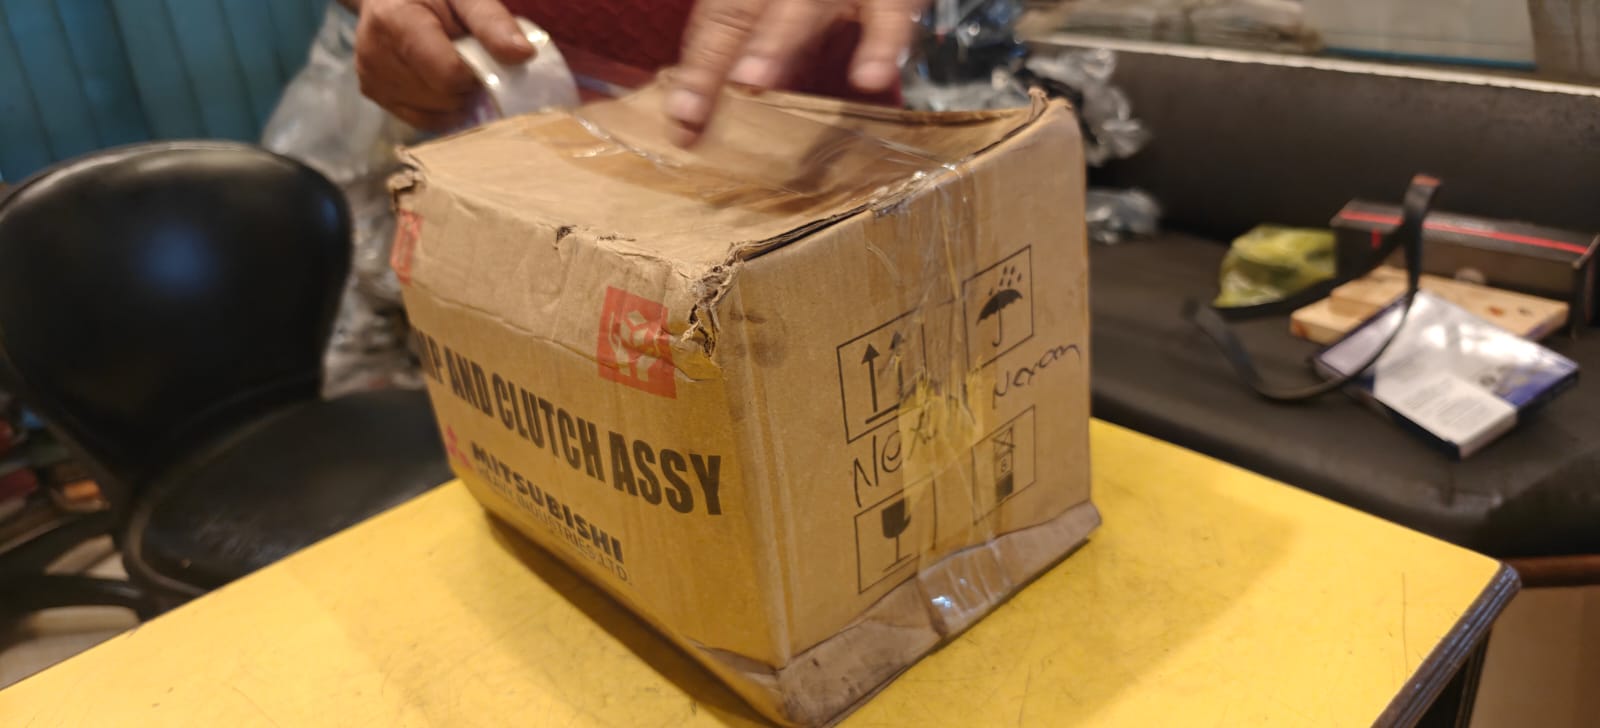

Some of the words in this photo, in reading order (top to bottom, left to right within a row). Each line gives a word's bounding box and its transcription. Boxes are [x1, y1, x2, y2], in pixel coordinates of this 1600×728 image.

[444, 344, 495, 419] AND
[493, 372, 605, 483] CLUTCH
[608, 431, 722, 515] ASSY
[471, 440, 624, 565] MITSUBISHI
